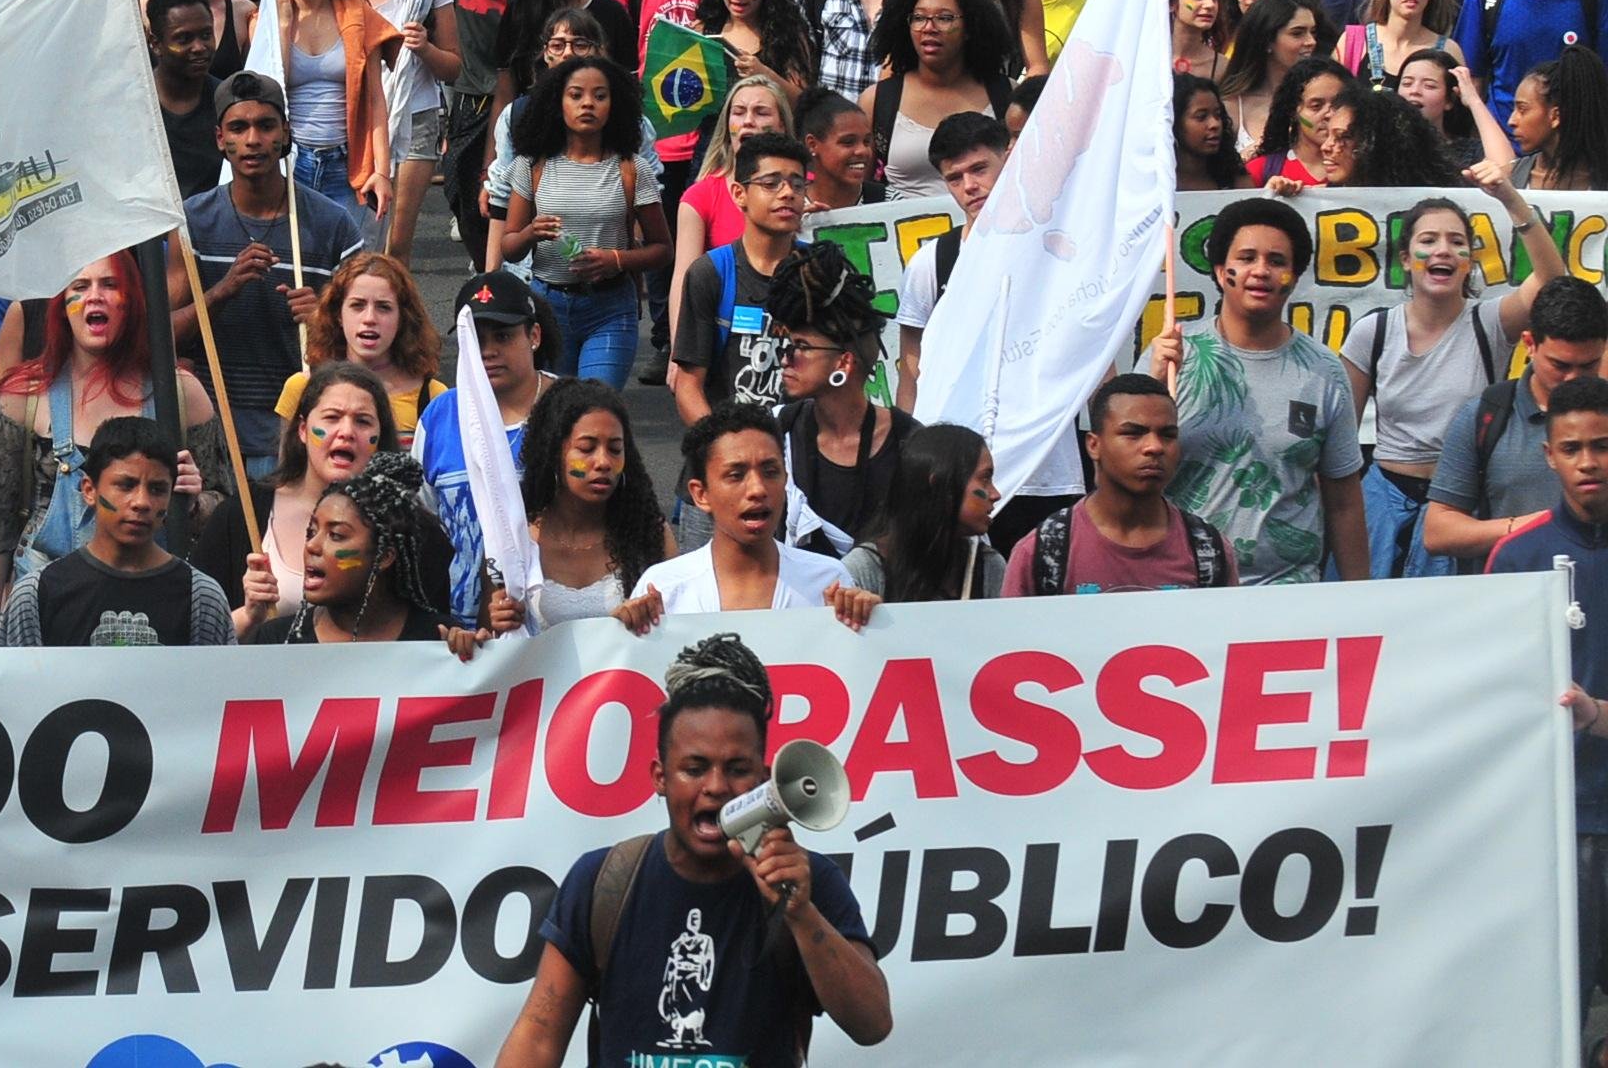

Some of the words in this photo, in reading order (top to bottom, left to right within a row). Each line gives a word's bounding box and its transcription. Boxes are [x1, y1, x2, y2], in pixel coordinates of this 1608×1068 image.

[201, 668, 667, 834] MEIO
[765, 635, 1383, 801] PASSE!
[846, 811, 1392, 963] ÚBLICO!
